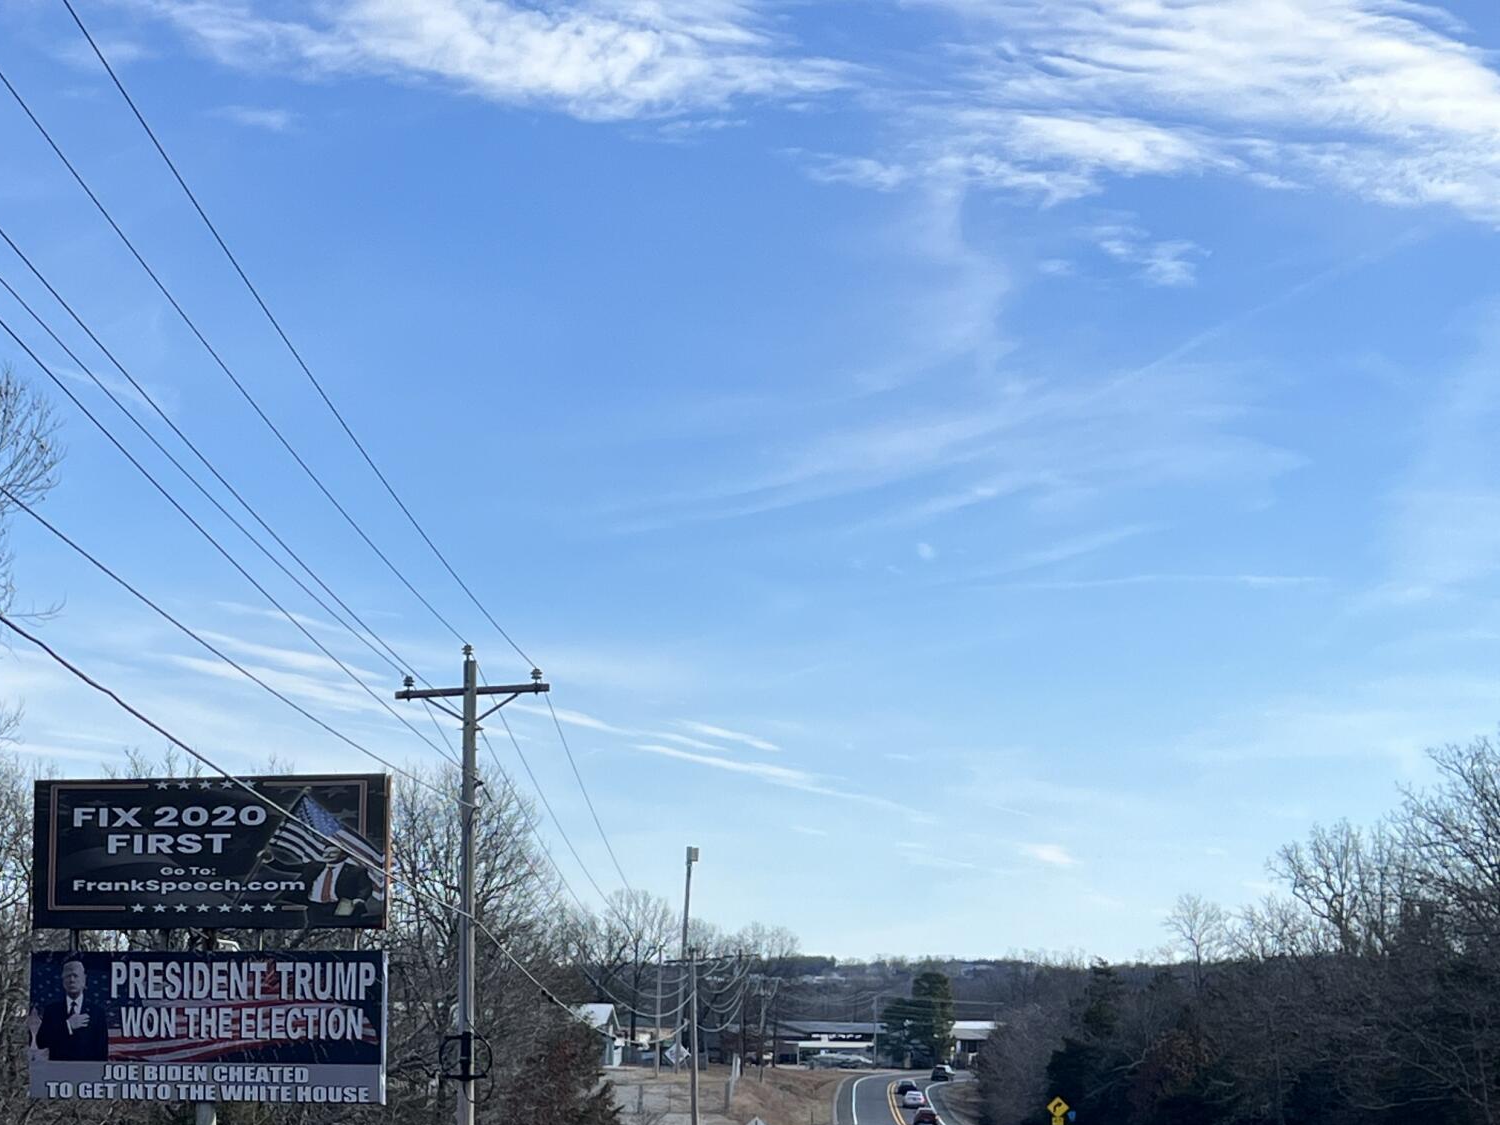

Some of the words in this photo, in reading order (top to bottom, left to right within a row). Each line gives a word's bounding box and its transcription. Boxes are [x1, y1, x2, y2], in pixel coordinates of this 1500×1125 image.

[73, 808, 141, 827] FIX
[154, 806, 267, 827] 2020
[107, 834, 231, 854] FIRST
[160, 867, 184, 876] Go
[189, 867, 216, 876] To:
[73, 880, 305, 894] FrankSpeech.com
[110, 962, 267, 999] PRESIDENT
[276, 961, 376, 1000] TRUMP
[121, 1007, 176, 1038] WON
[184, 1008, 233, 1039] THE
[241, 1008, 364, 1040] ELECTION
[103, 1065, 139, 1081] JOE
[144, 1065, 207, 1082] BIDEN
[213, 1066, 308, 1083] CHEATED
[47, 1083, 73, 1098] TO
[78, 1083, 116, 1099] GET
[120, 1083, 171, 1099] INTO
[177, 1084, 216, 1100] THE
[222, 1085, 294, 1101] WHITE
[297, 1086, 369, 1102] HOUSE
